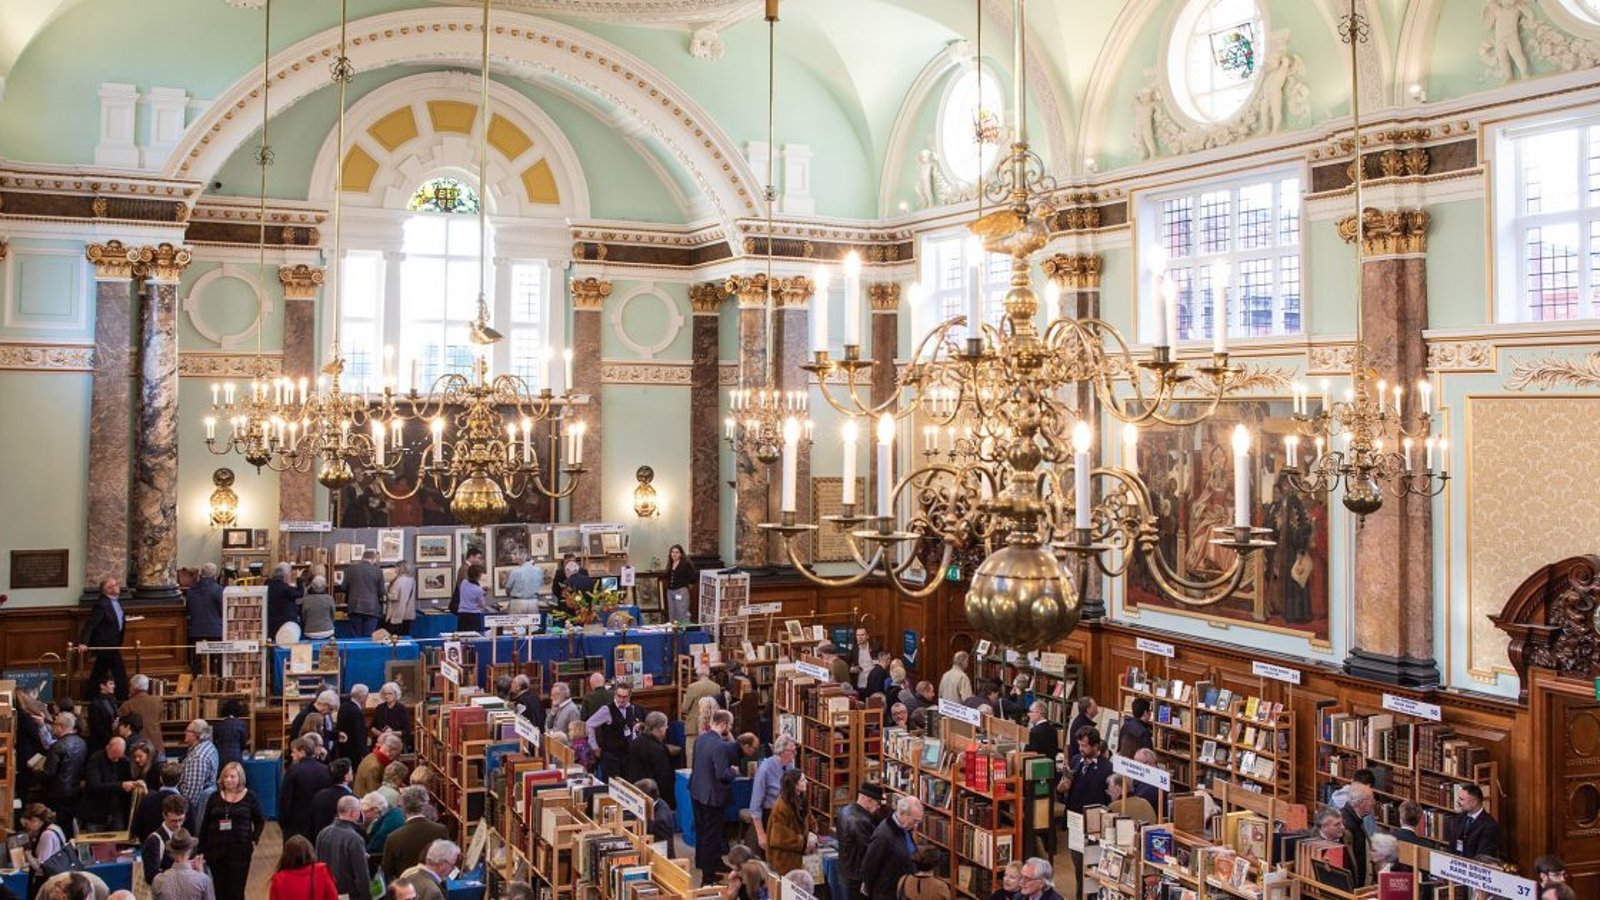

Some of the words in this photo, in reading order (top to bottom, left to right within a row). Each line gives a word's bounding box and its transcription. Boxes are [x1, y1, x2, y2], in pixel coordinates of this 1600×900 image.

[1449, 866, 1468, 876] RARE
[1468, 871, 1492, 884] BOOKS
[1450, 858, 1468, 868] JOHN
[1469, 863, 1492, 876] DRURY
[1516, 885, 1531, 896] 37
